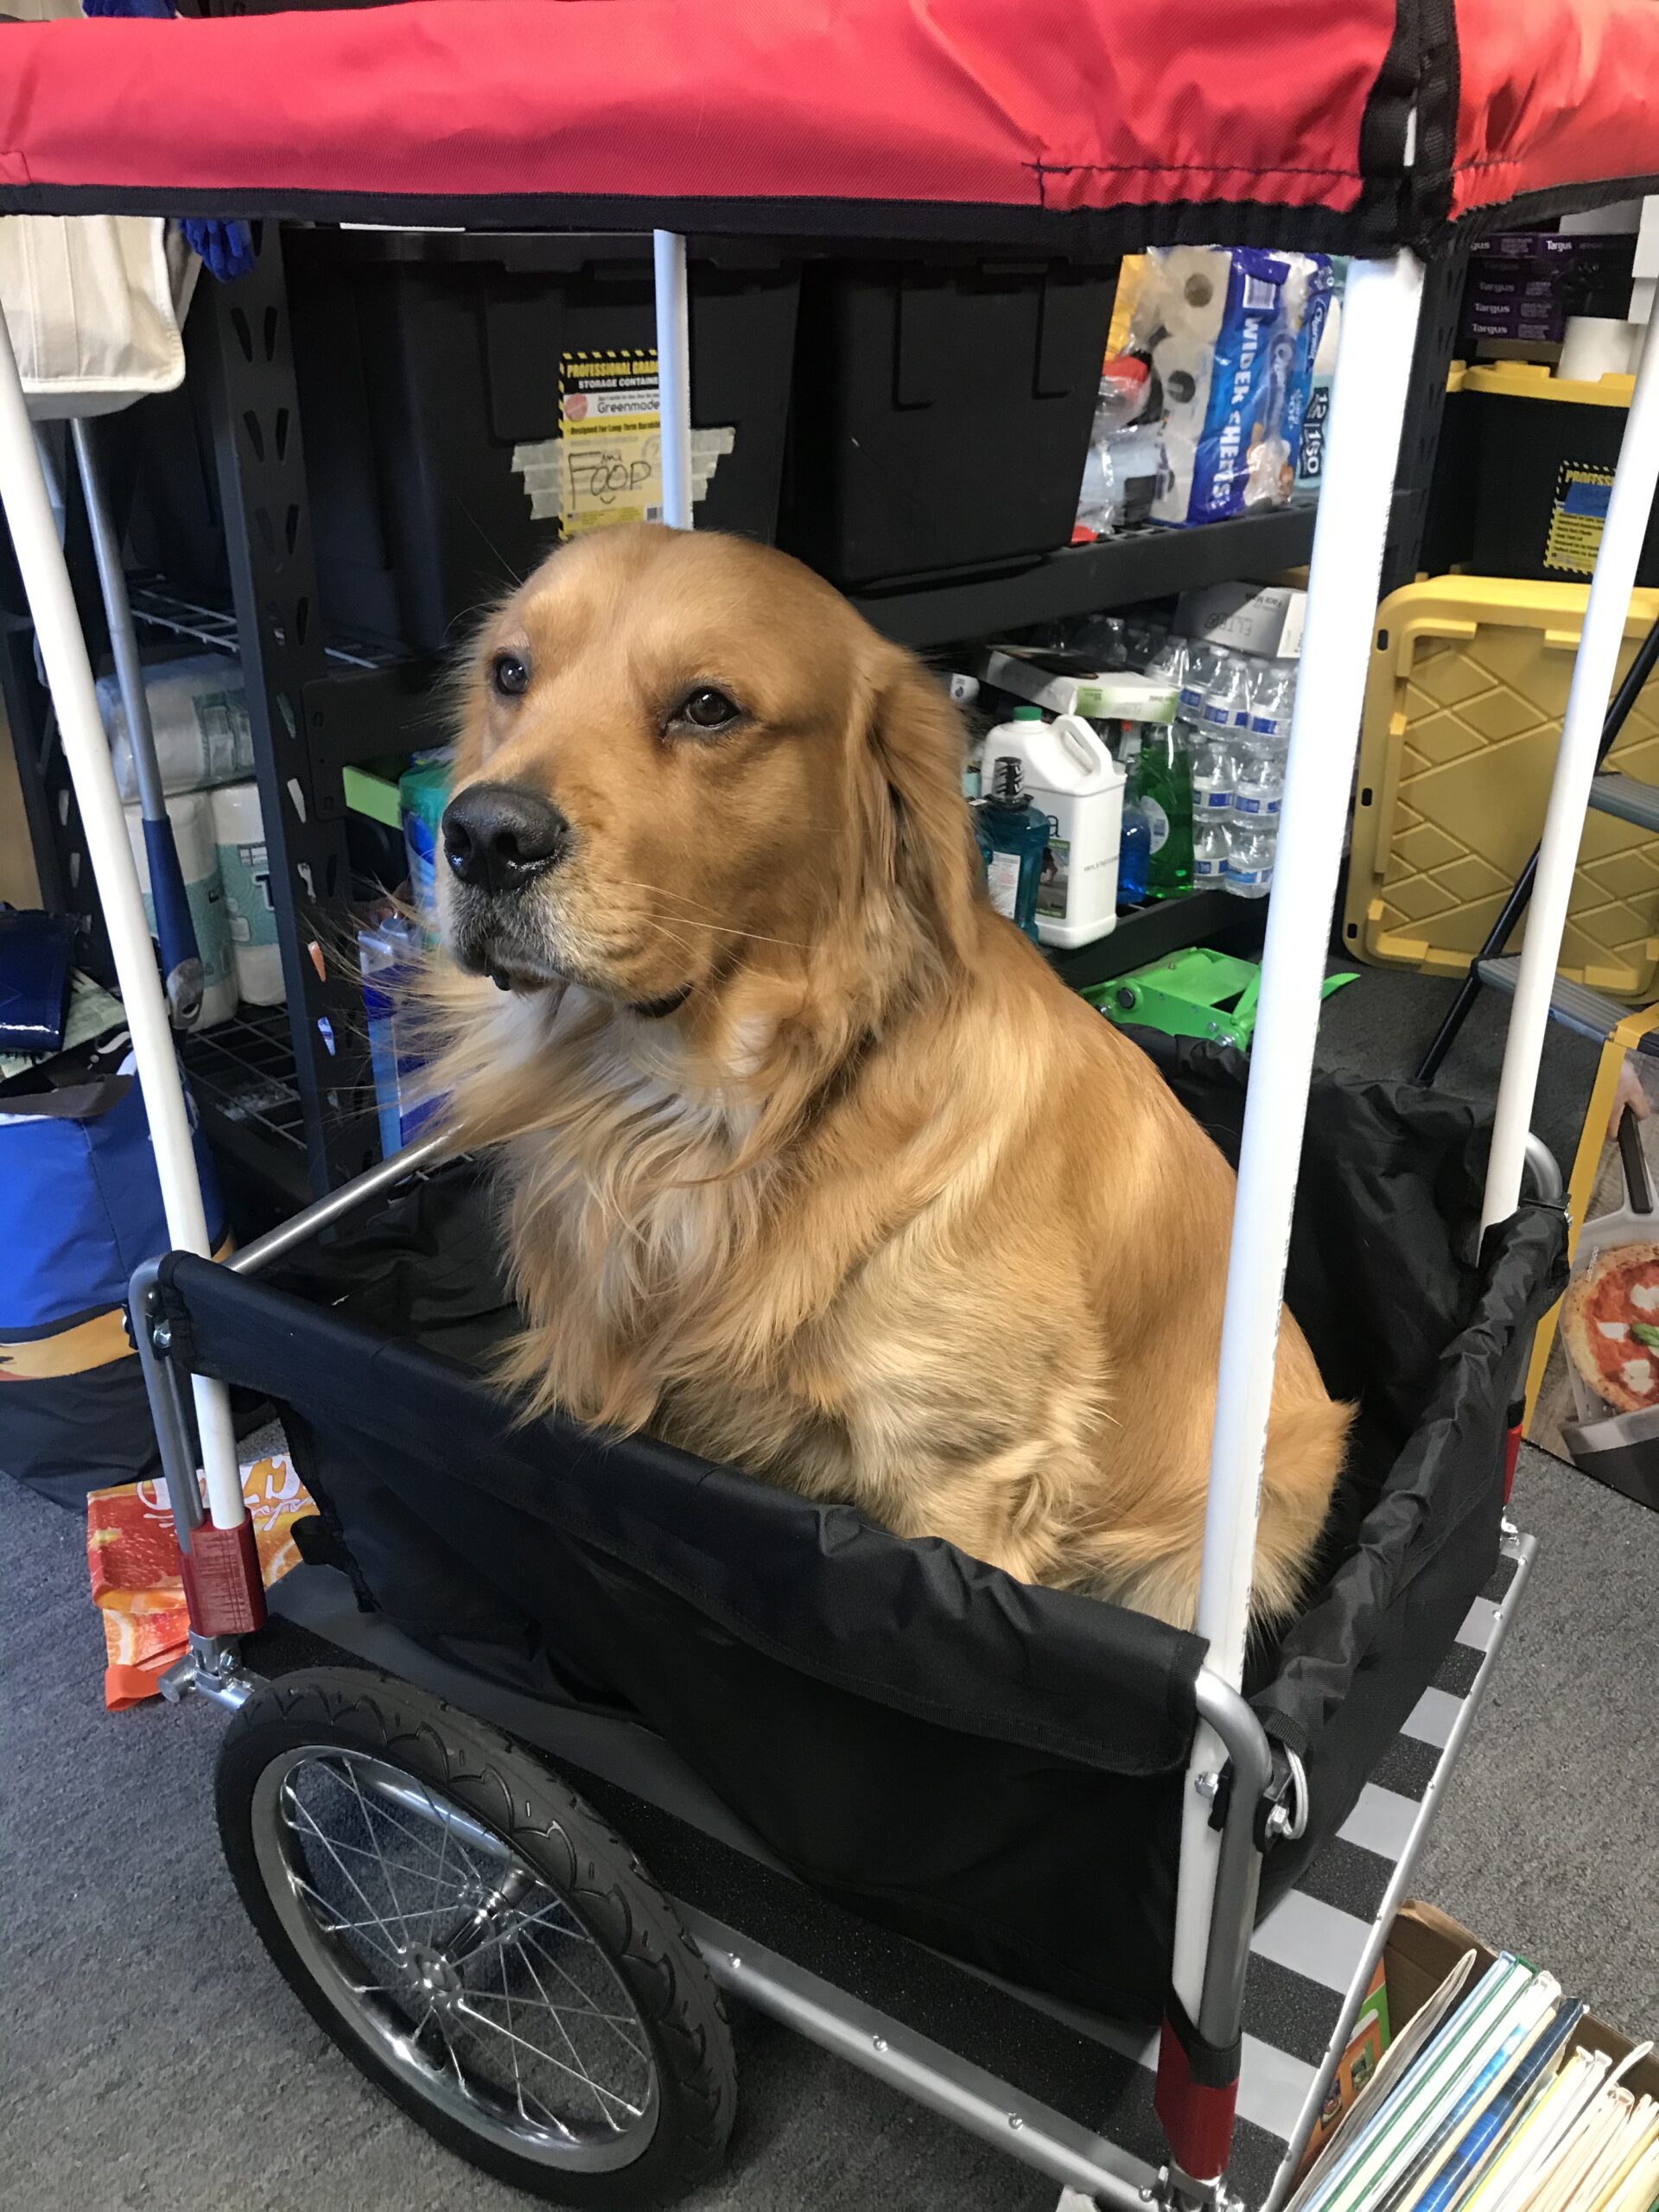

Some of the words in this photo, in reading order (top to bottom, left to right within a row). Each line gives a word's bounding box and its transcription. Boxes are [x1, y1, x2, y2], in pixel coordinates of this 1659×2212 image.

[1547, 240, 1573, 252] Targus
[1478, 282, 1515, 294] Targus
[1474, 302, 1510, 315] Targus
[1471, 323, 1508, 335] Targus
[566, 362, 632, 378] PROFESSIONAL
[578, 378, 618, 389] STORAGE
[597, 399, 660, 414] Greenmade
[1312, 393, 1328, 419] 12
